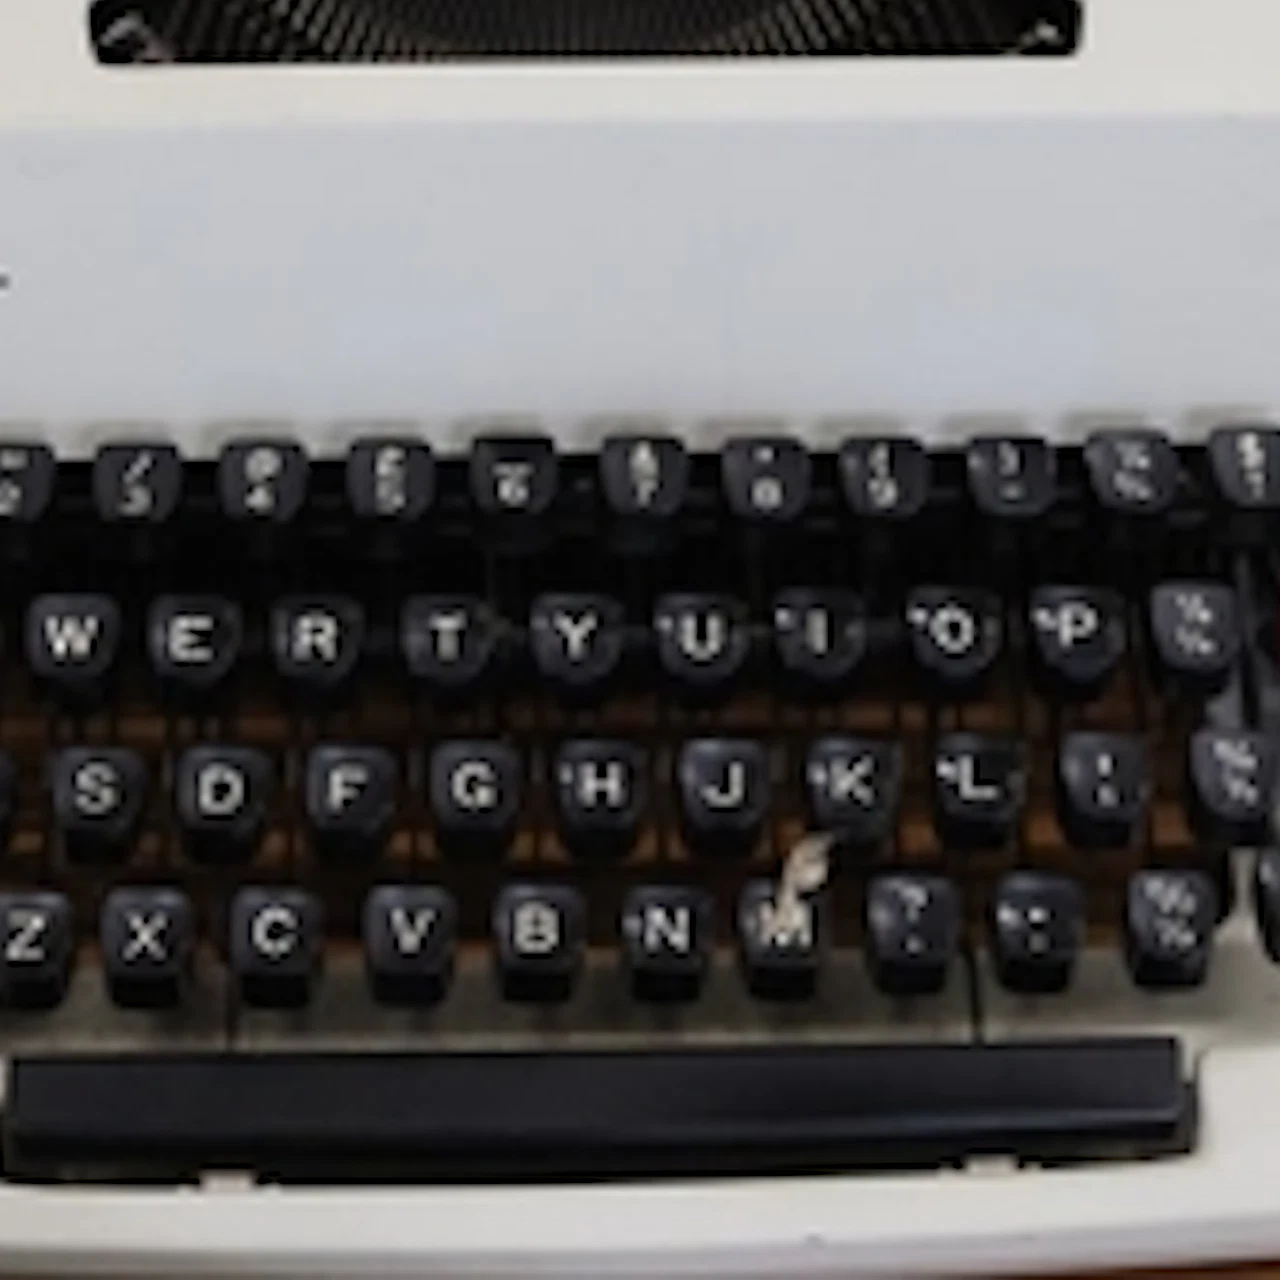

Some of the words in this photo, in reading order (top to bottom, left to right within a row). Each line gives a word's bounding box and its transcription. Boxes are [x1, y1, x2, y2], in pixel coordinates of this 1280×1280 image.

[45, 615, 98, 657] W
[165, 614, 215, 662] E
[293, 615, 337, 660] R
[430, 614, 464, 656] T
[554, 614, 597, 657] Y
[678, 613, 723, 660] U
[805, 610, 828, 654] I
[928, 606, 974, 653] O
[1051, 602, 1098, 647] P
[74, 762, 115, 814] S
[198, 763, 244, 814] D
[327, 765, 367, 810] F
[451, 761, 494, 807] G
[577, 762, 622, 804] H
[699, 761, 744, 807] J
[829, 758, 871, 802] K
[954, 754, 999, 800] L
[6, 911, 46, 961] Z
[124, 913, 166, 958] X
[252, 905, 296, 954] C
[390, 905, 435, 953] V
[514, 902, 559, 953] B
[644, 907, 690, 951] N
